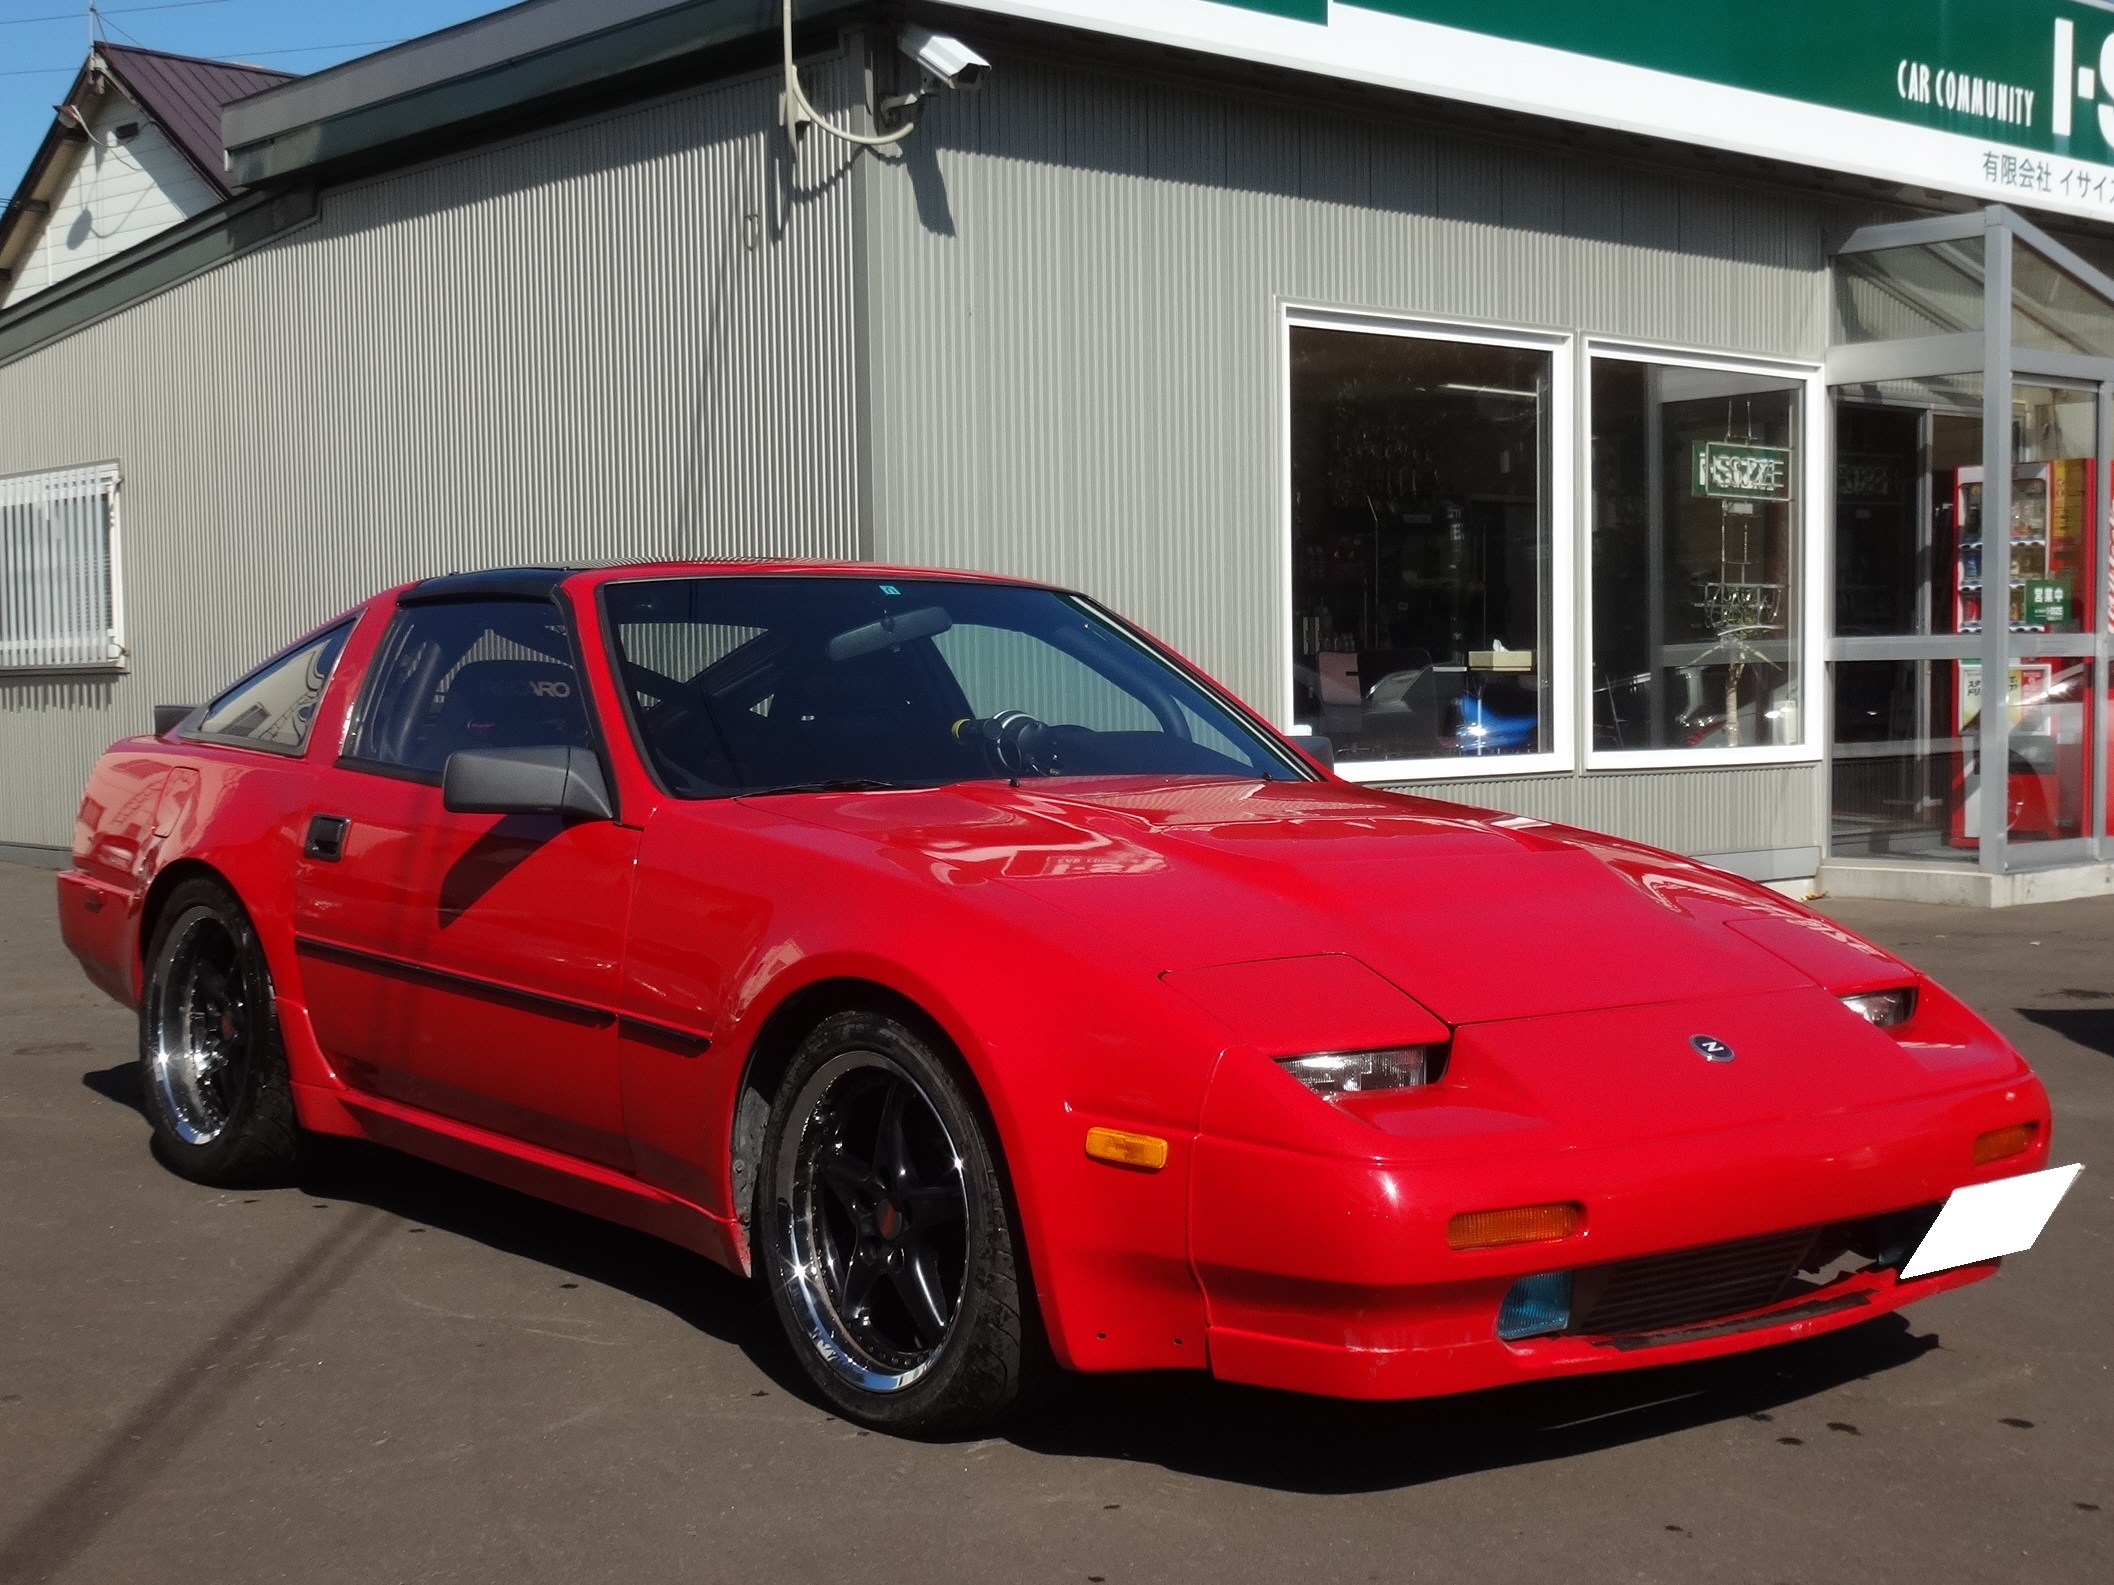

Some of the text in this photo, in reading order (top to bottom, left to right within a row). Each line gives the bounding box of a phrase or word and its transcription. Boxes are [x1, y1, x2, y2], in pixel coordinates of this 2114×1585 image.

[1897, 59, 1930, 104] CAR
[1935, 69, 2034, 127] COMMUNITY
[1982, 151, 2114, 204] 有限会社 イサイ
